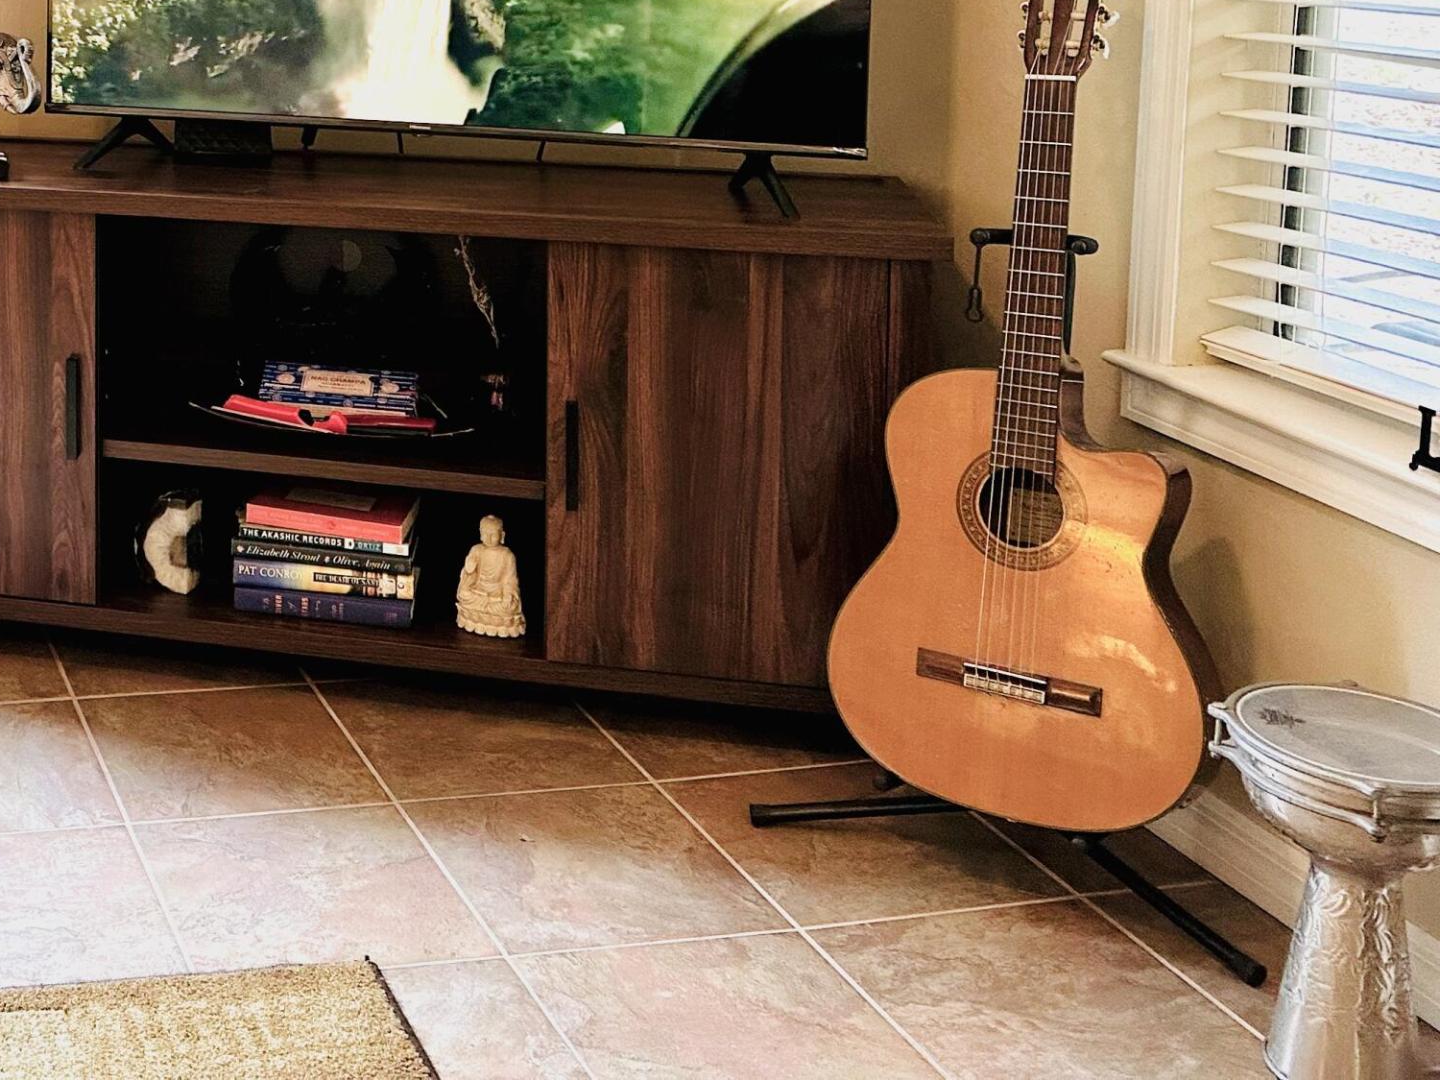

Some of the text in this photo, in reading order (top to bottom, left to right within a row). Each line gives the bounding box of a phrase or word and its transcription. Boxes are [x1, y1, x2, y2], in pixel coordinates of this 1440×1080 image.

[242, 527, 343, 548] THE AKASHIC RECORDS
[246, 544, 290, 558] Elizabeth
[238, 564, 257, 576] PAT
